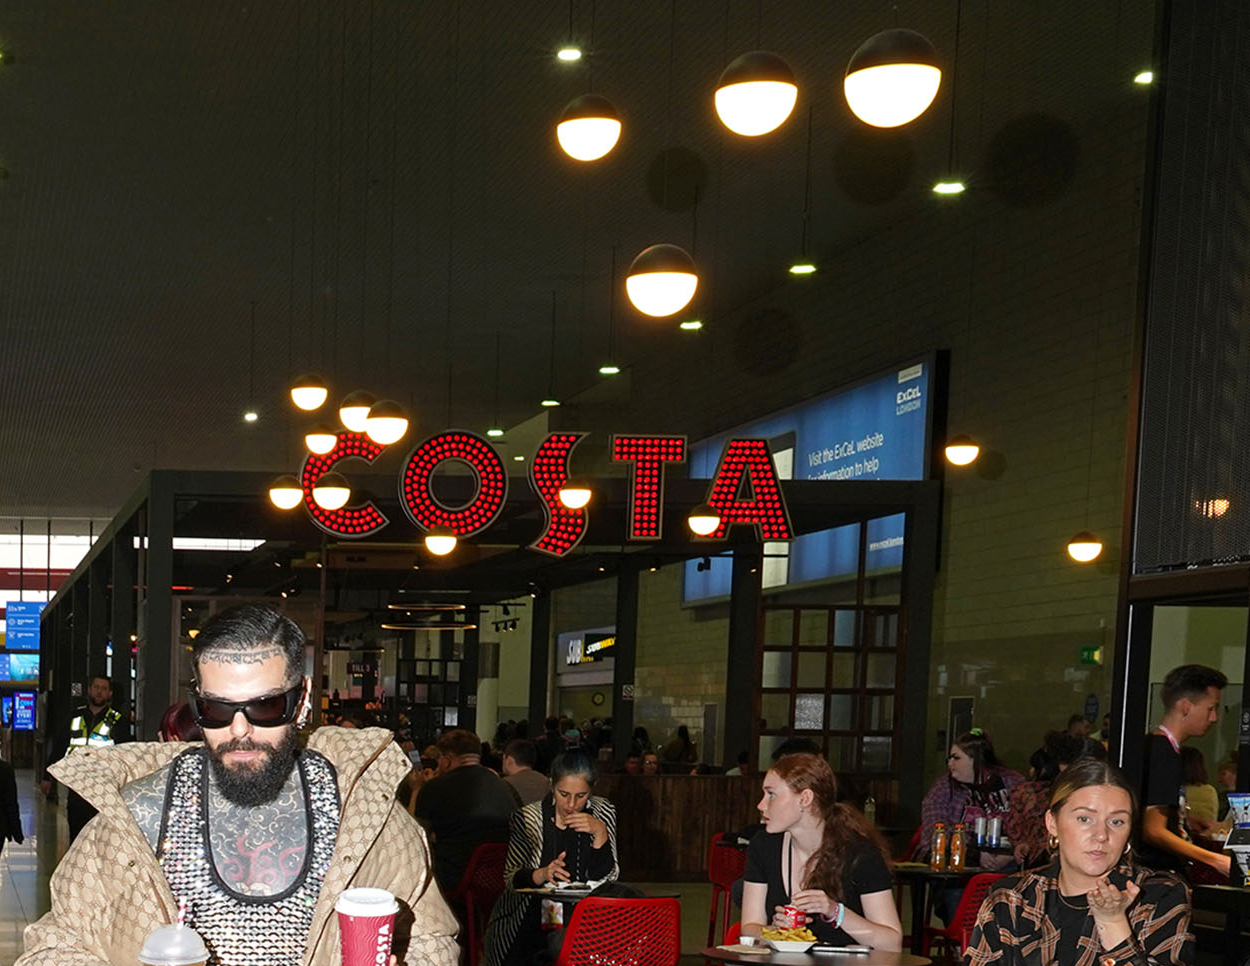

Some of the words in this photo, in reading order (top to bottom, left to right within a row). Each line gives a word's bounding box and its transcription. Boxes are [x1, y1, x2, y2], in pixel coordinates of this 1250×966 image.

[808, 450, 823, 467] Visit
[823, 447, 834, 463] the
[834, 440, 856, 460] ExCeL
[856, 432, 885, 453] website
[854, 462, 863, 476] to
[863, 456, 880, 475] help
[300, 429, 796, 557] COSTA
